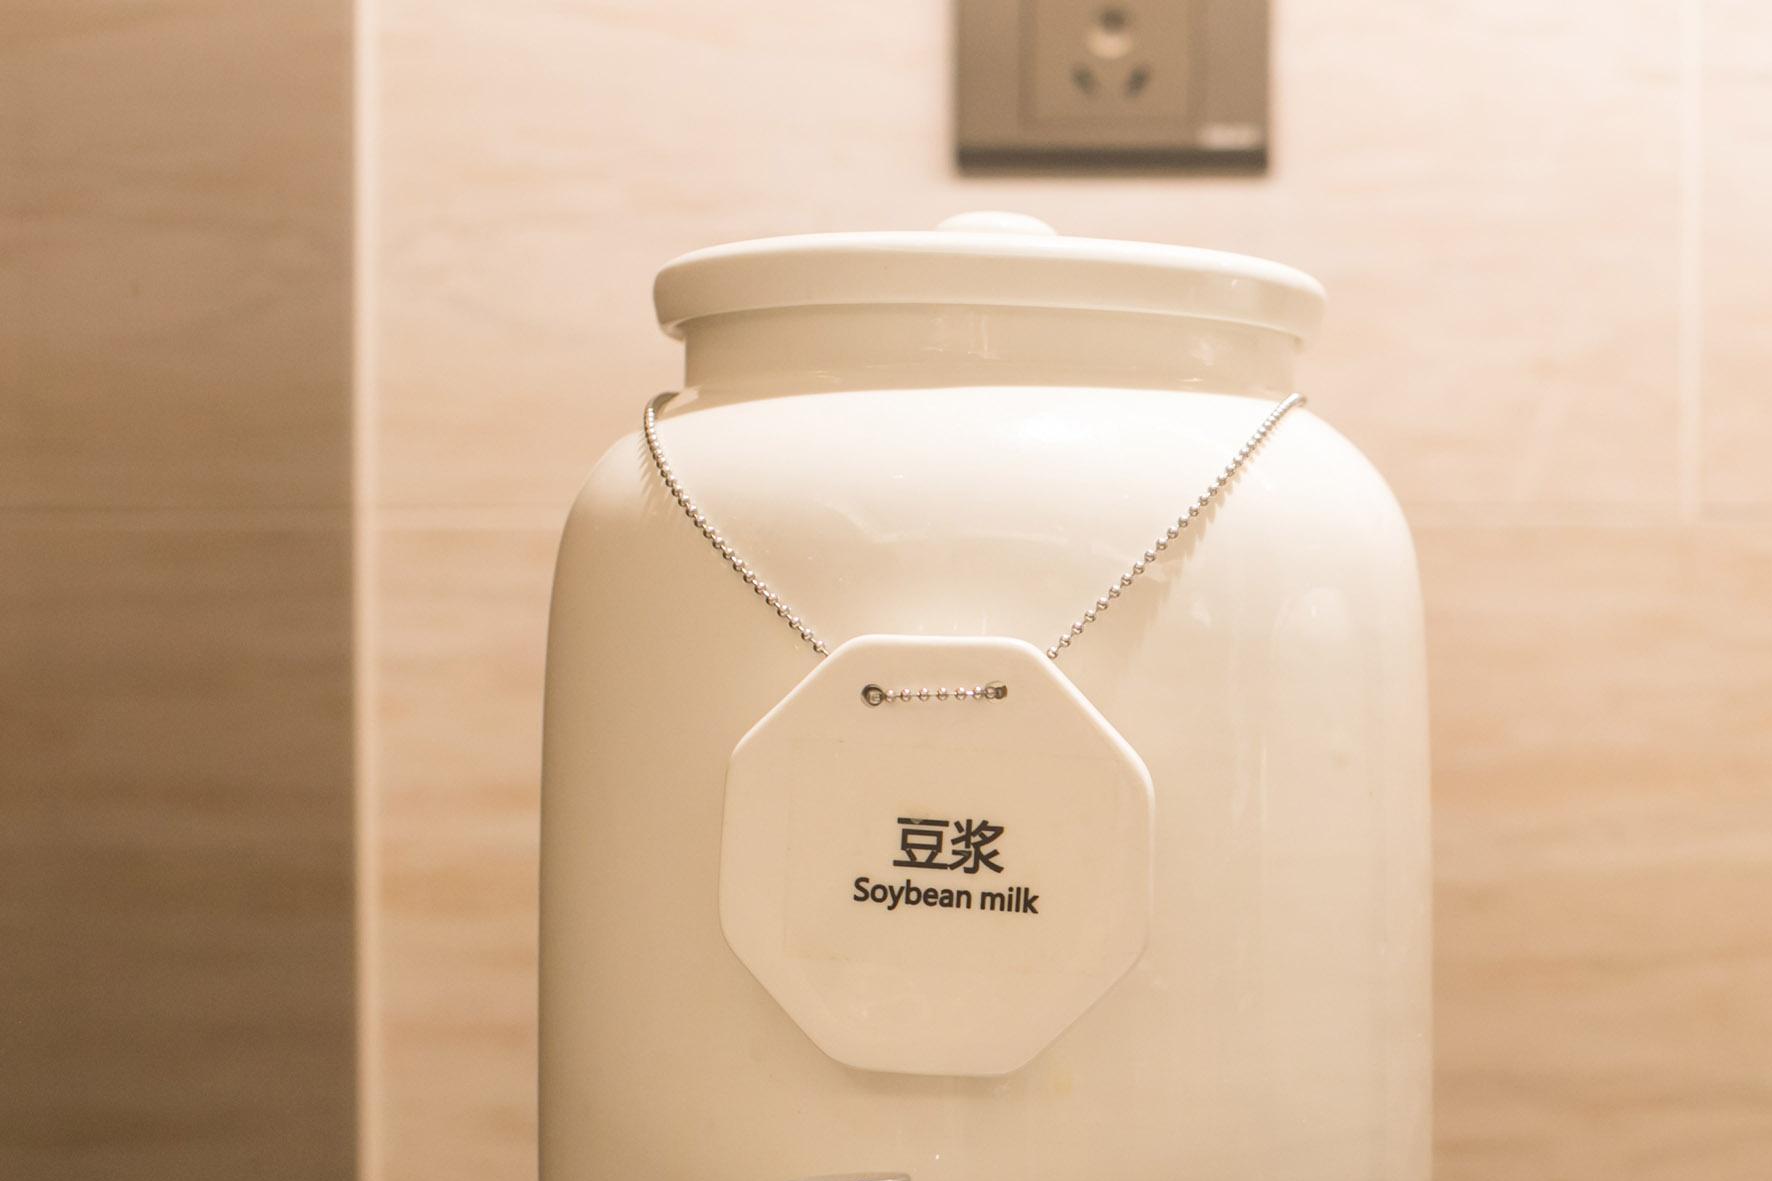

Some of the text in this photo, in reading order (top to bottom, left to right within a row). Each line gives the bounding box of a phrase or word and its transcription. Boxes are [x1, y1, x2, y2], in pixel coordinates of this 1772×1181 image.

[893, 817, 1004, 874] 豆浆
[853, 877, 1039, 914] Soybean milk
